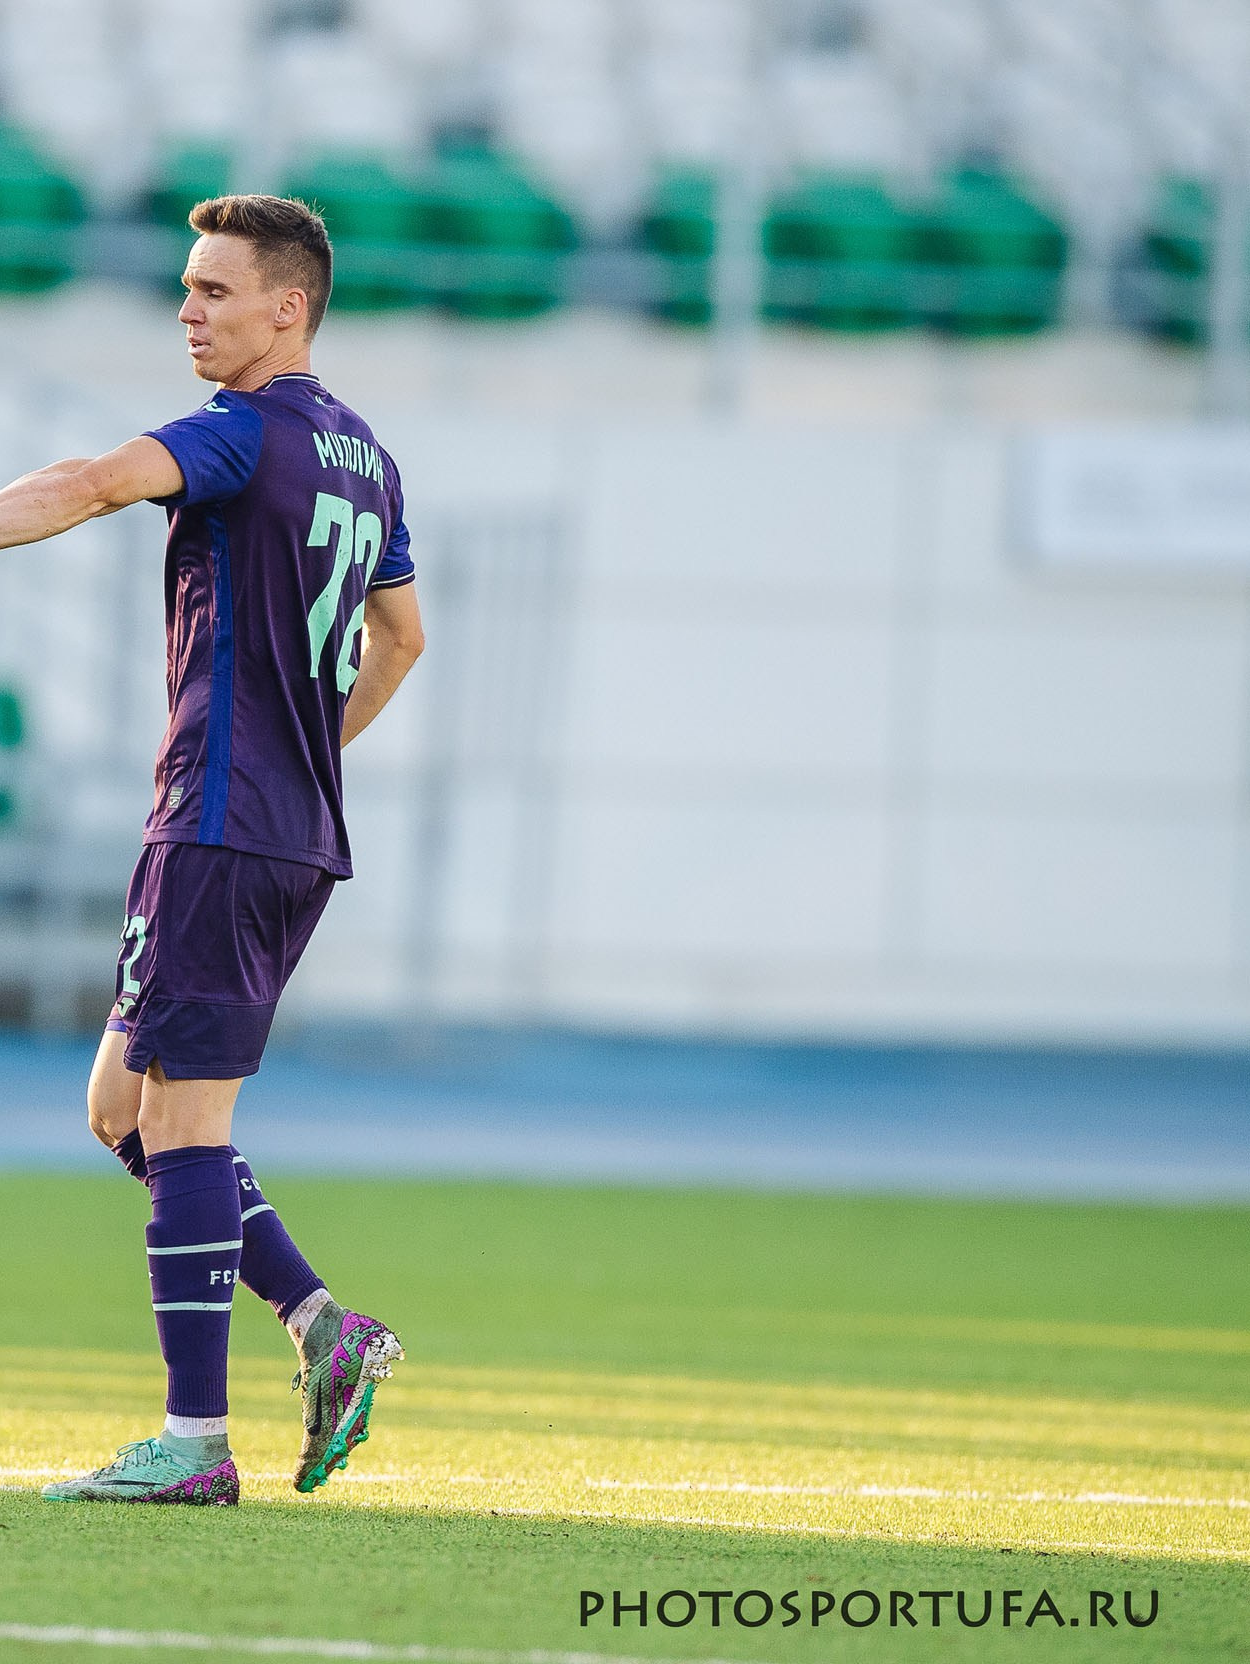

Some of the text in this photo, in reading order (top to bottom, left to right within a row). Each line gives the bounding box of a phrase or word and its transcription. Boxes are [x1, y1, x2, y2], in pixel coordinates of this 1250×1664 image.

[312, 430, 384, 492] МУЛЛИН
[306, 491, 383, 697] 72
[119, 913, 147, 995] 2
[209, 1269, 233, 1286] FC
